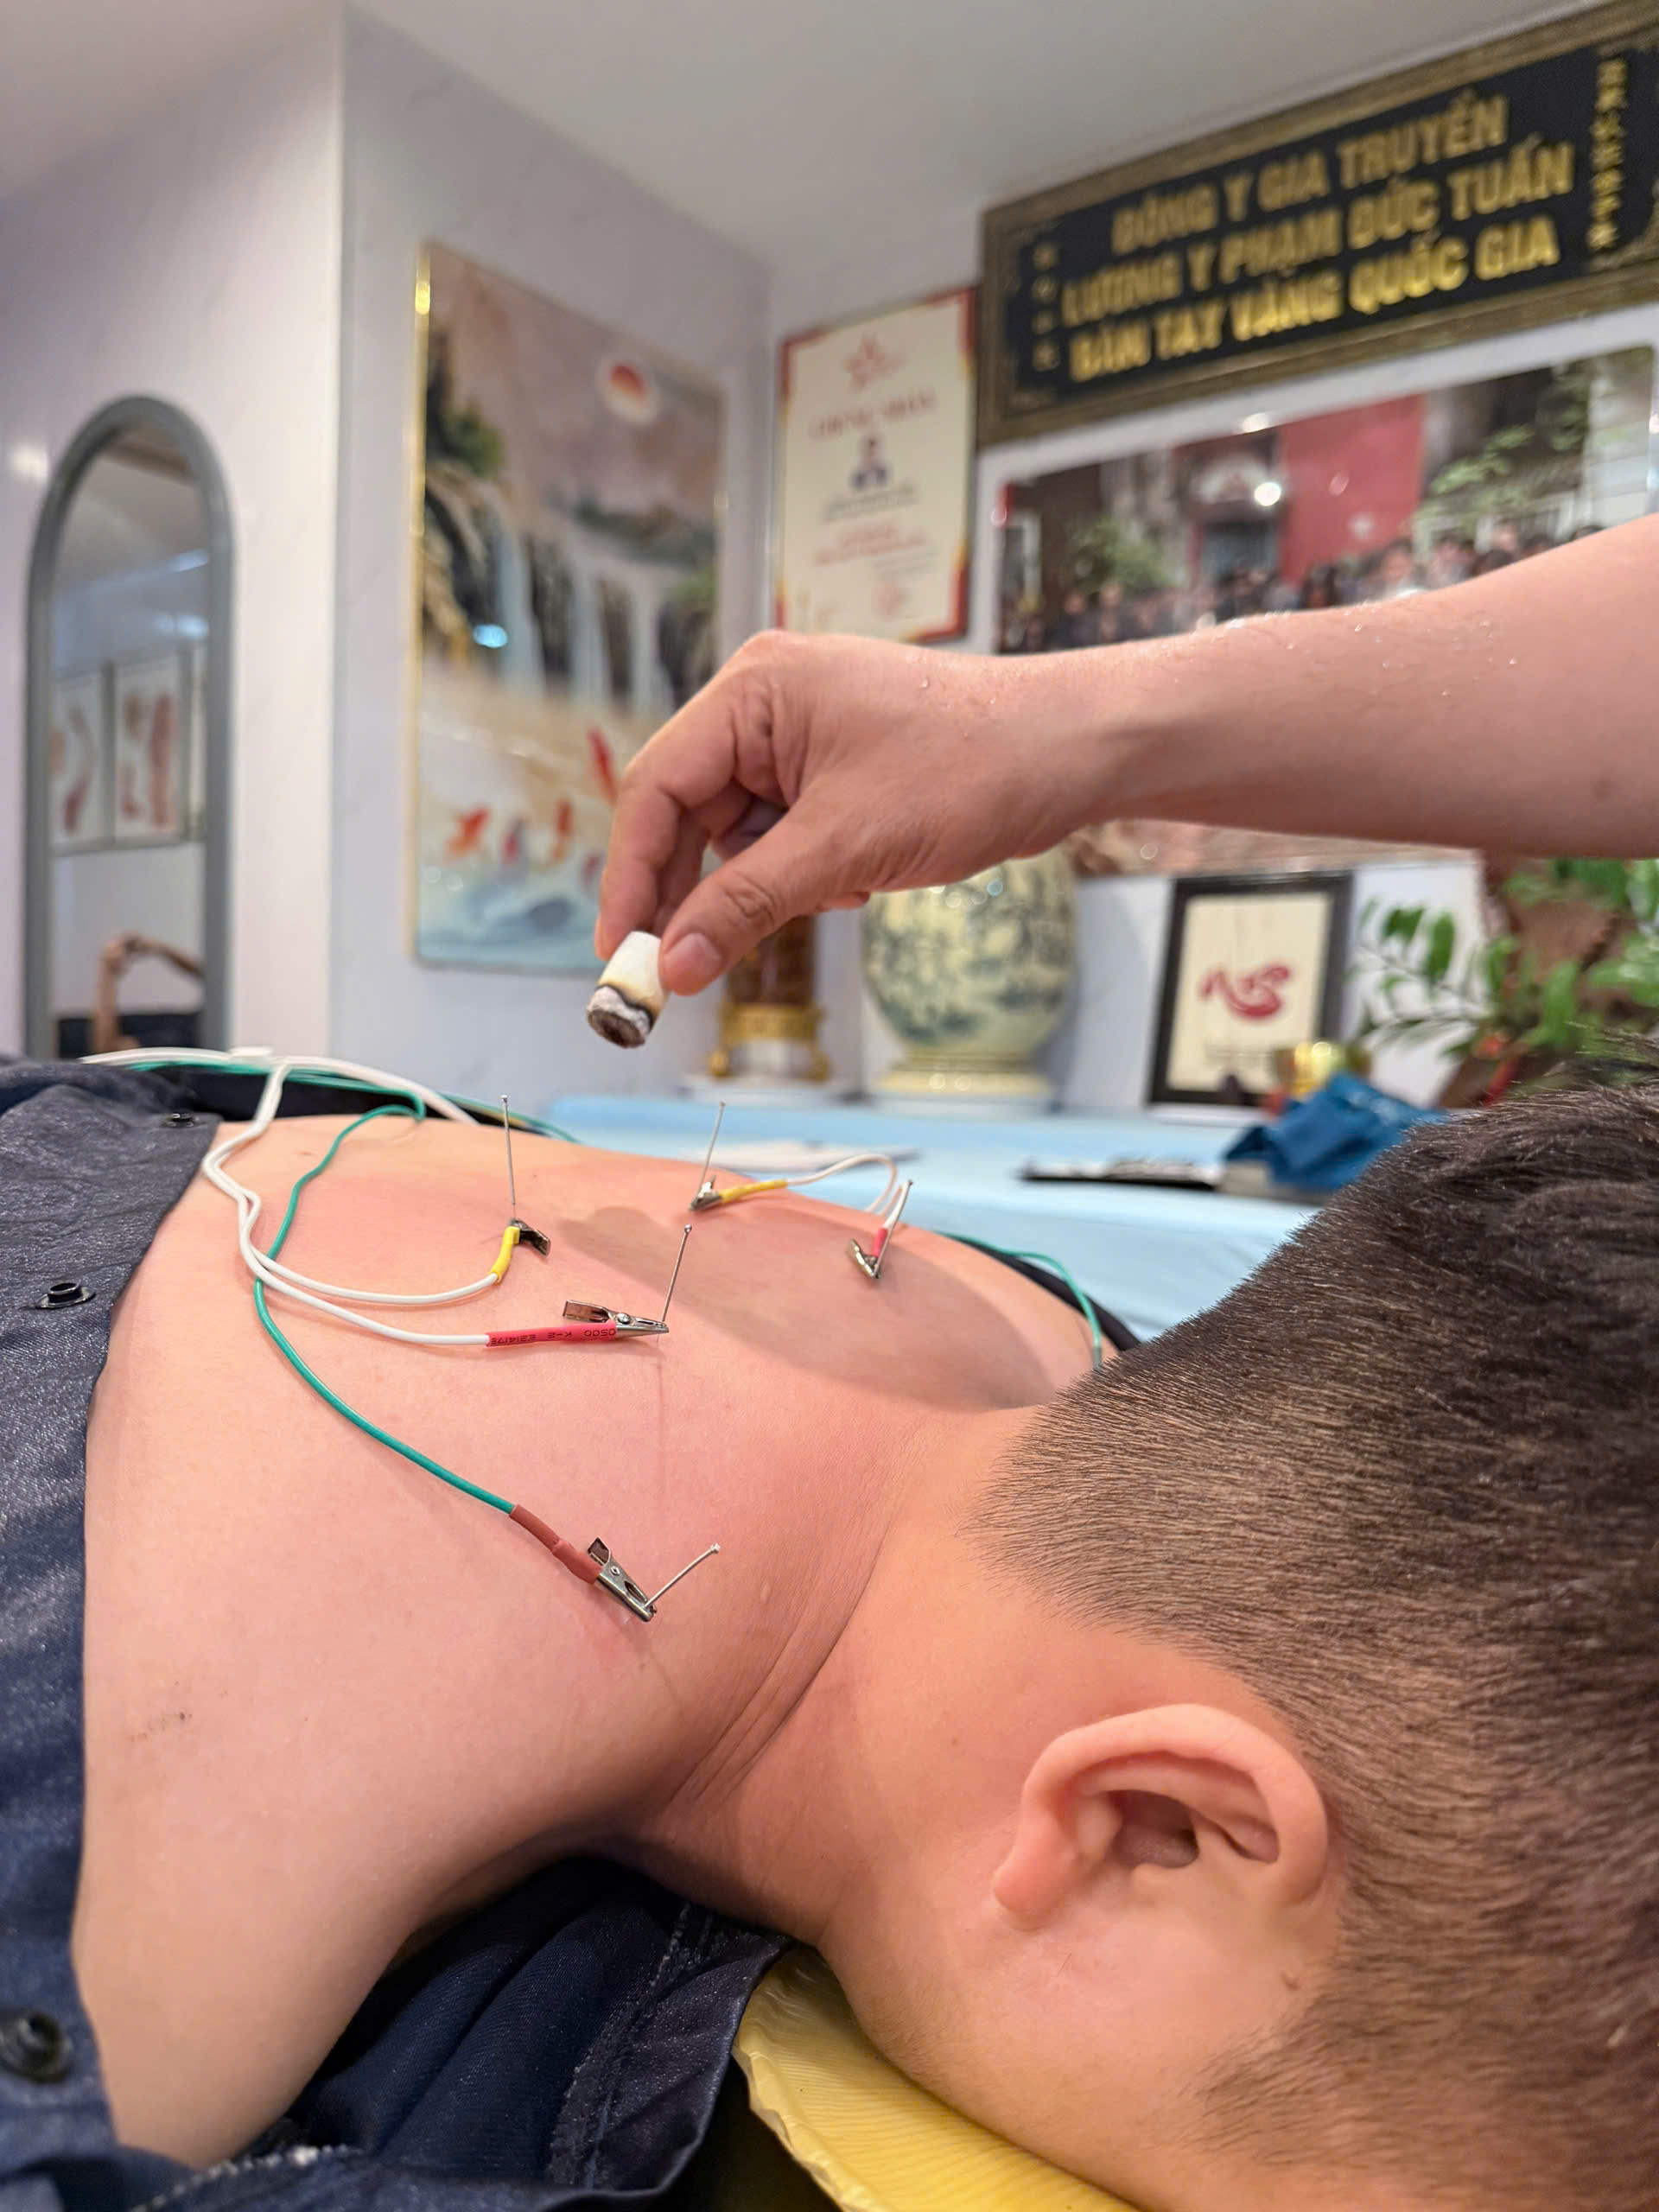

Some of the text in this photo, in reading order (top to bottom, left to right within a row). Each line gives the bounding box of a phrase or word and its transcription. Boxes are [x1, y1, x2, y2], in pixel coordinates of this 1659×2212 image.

[1224, 175, 1251, 222] Y
[1258, 151, 1330, 212] GIA
[1154, 300, 1224, 359] TAY
[1474, 216, 1560, 280] GIA
[1186, 243, 1215, 291] Y
